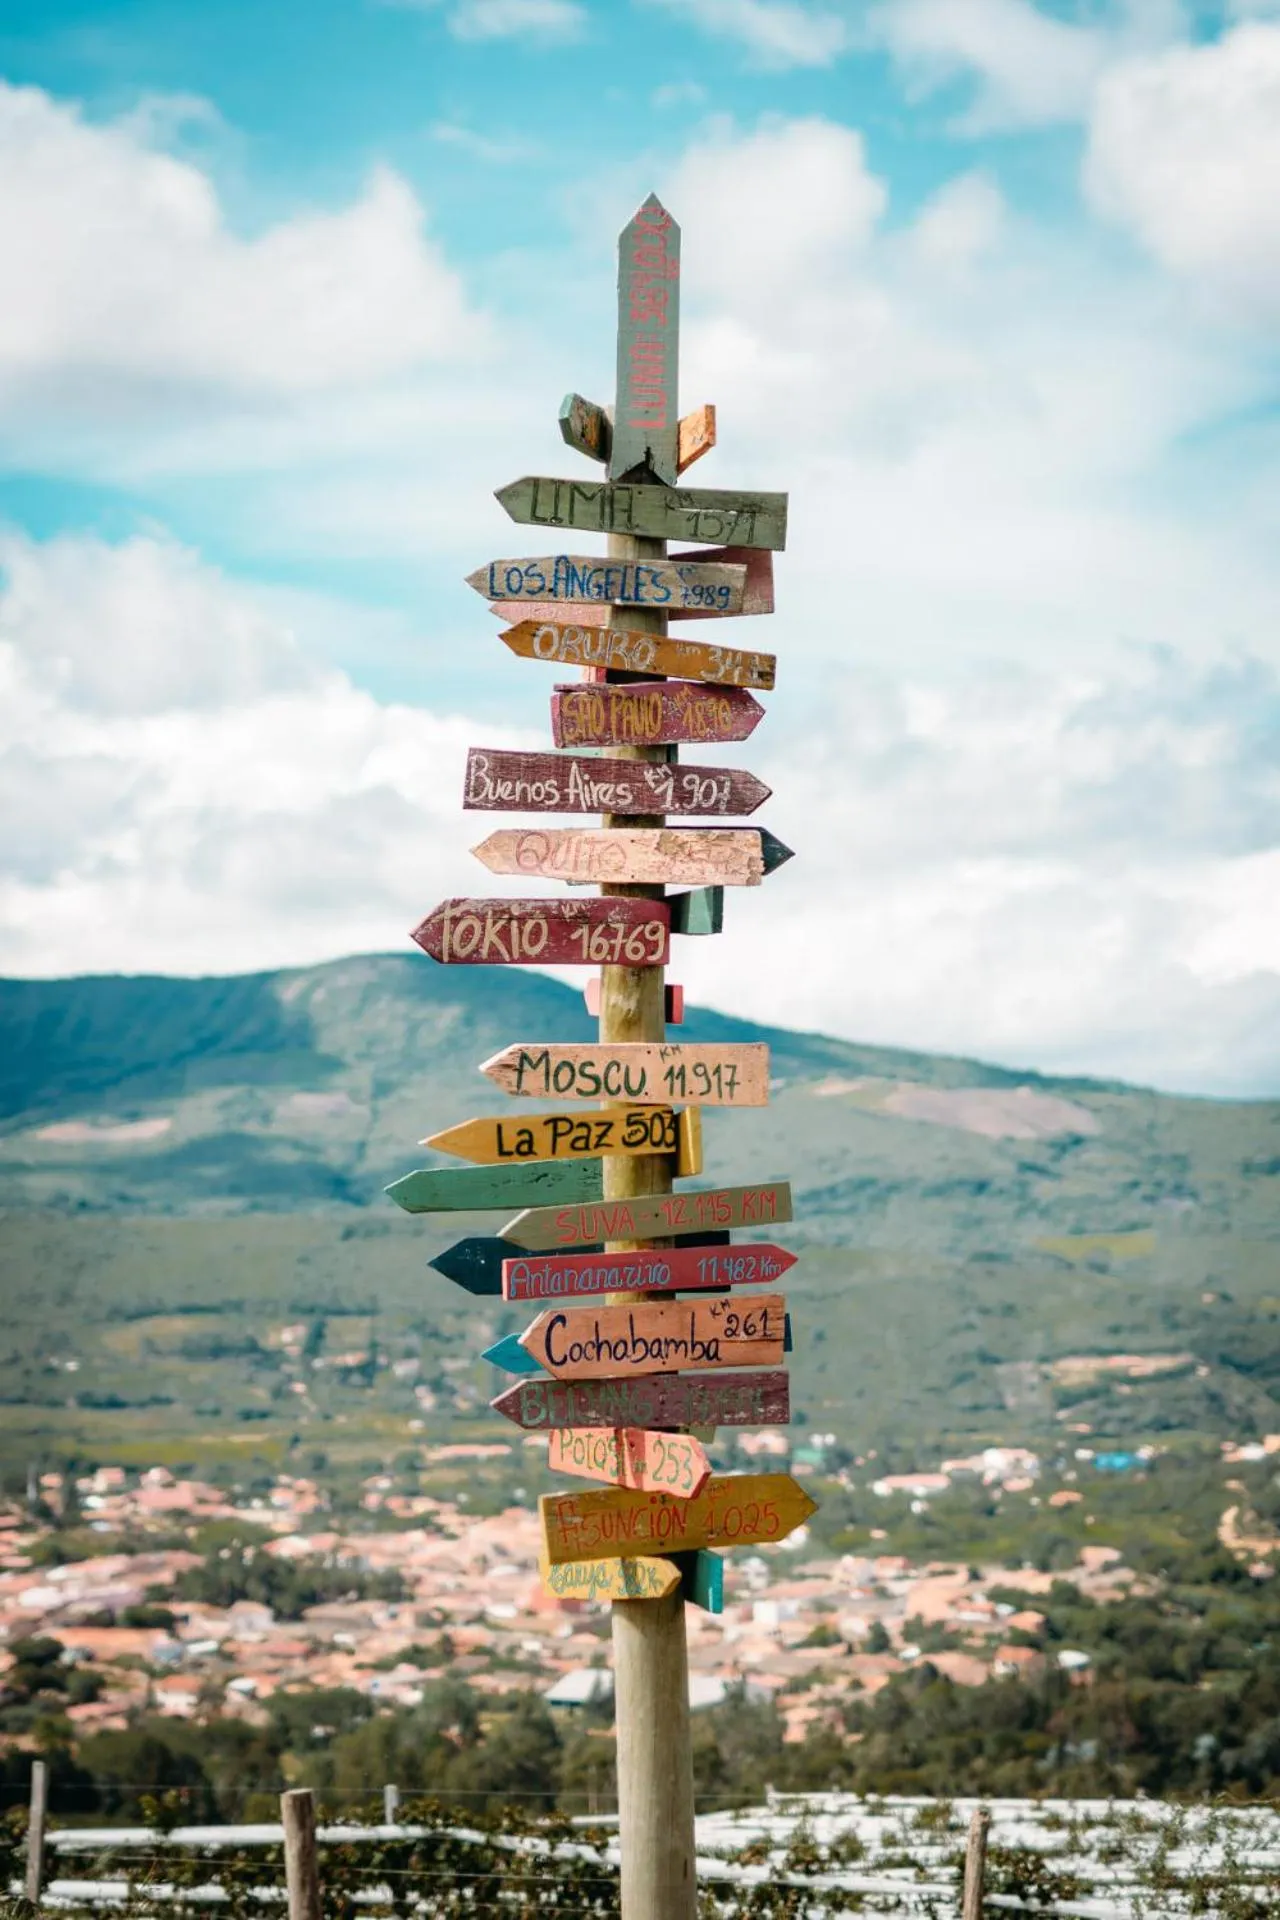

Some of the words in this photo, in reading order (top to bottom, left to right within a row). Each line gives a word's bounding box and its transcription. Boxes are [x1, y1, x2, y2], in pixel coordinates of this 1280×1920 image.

[530, 478, 638, 529] LIMA
[533, 624, 655, 671] ORURO
[469, 754, 558, 805] Buenos
[565, 761, 633, 812] Aires
[516, 831, 627, 873] QUITO
[570, 920, 665, 961] 16.769
[662, 1064, 740, 1098] 11.917
[496, 1122, 537, 1157] La
[543, 1116, 614, 1155] Paz
[555, 1206, 635, 1243] SUVA
[742, 1190, 777, 1221] KM
[697, 1256, 756, 1283] 11.482
[545, 1312, 722, 1367] Cochabamba
[723, 1309, 775, 1338] 261
[652, 1439, 693, 1489] 253
